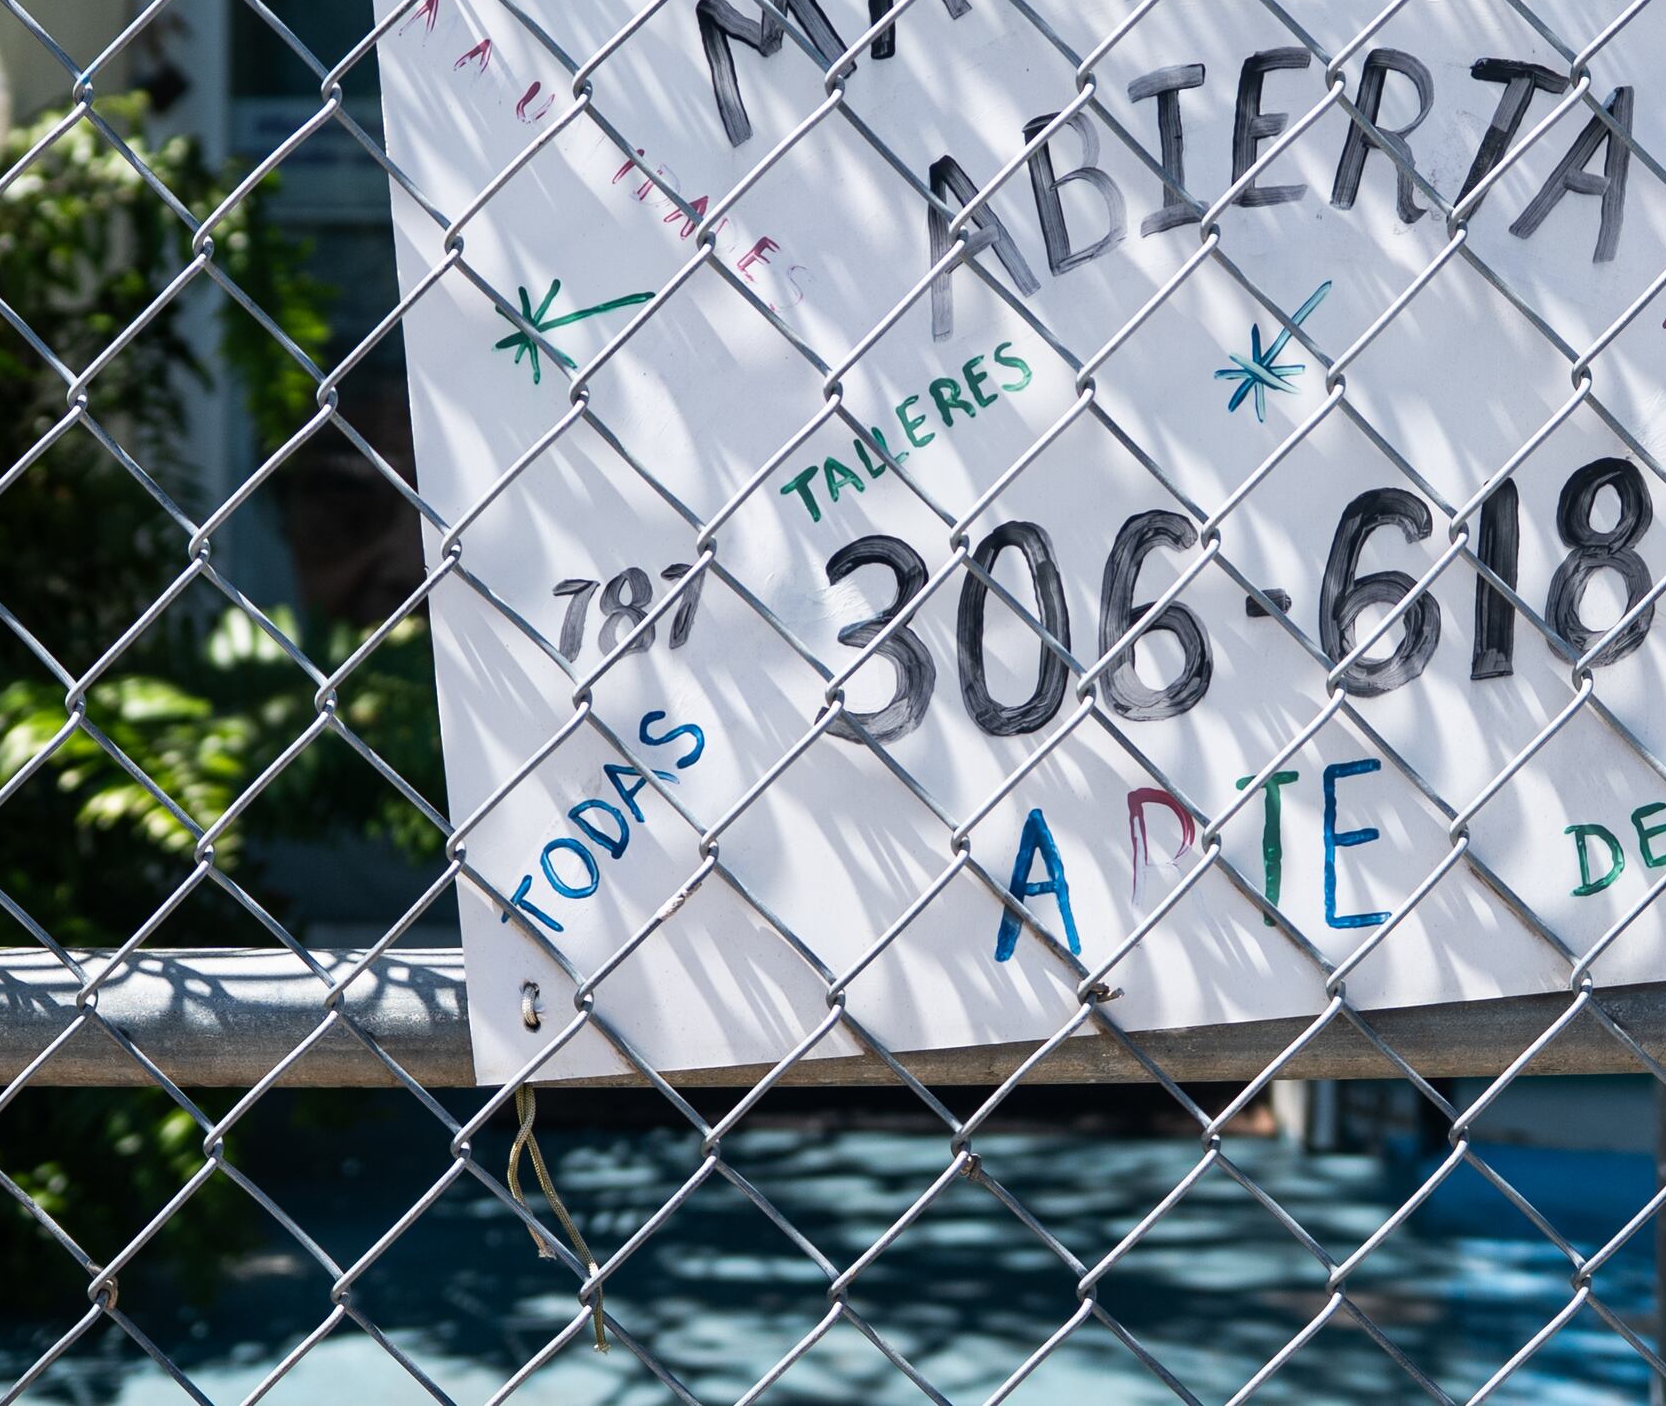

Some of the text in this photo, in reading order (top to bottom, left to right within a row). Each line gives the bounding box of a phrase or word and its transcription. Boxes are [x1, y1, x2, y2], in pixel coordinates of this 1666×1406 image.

[928, 47, 1635, 341] ABIERTA
[780, 341, 1033, 523] TALLERES
[552, 562, 707, 663] 787
[500, 709, 705, 933] TODAS
[995, 757, 1393, 963] ARTE
